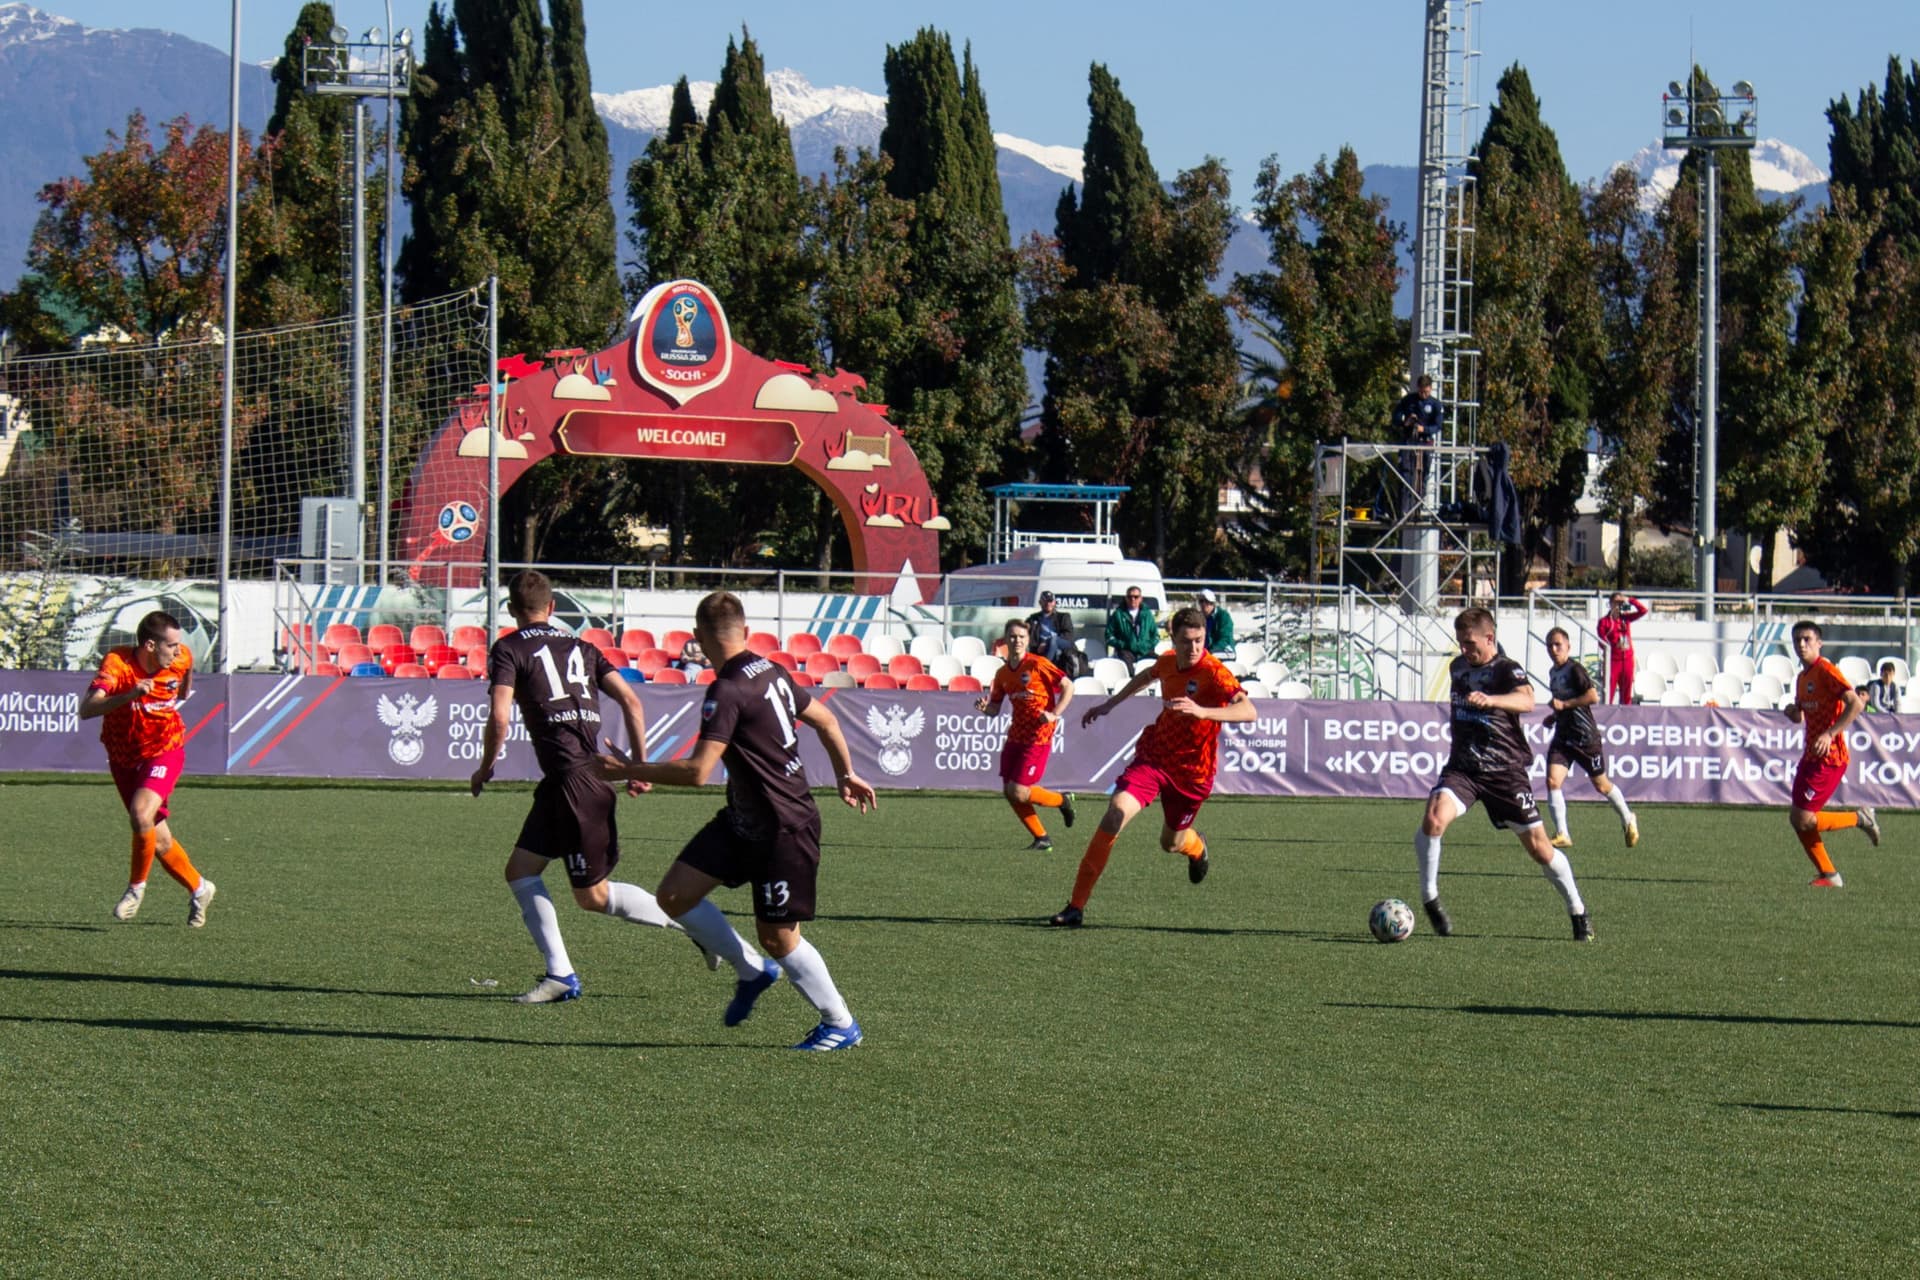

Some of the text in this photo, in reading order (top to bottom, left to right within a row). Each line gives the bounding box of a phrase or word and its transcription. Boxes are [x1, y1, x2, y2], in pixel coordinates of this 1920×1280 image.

[661, 352, 707, 362] RUSSIA 2018
[665, 369, 701, 381] SOCHI
[637, 427, 726, 447] WELCOME!
[1056, 597, 1089, 609] ЗАКАЗ
[533, 644, 592, 702] 14
[1223, 717, 1287, 735] СОЧИ
[1248, 738, 1287, 748] НОЯБРЯ
[935, 751, 992, 771] СОЮЗ
[1224, 750, 1287, 773] 2021
[150, 766, 168, 779] 20
[568, 853, 587, 869] 14
[762, 880, 790, 907] 13
